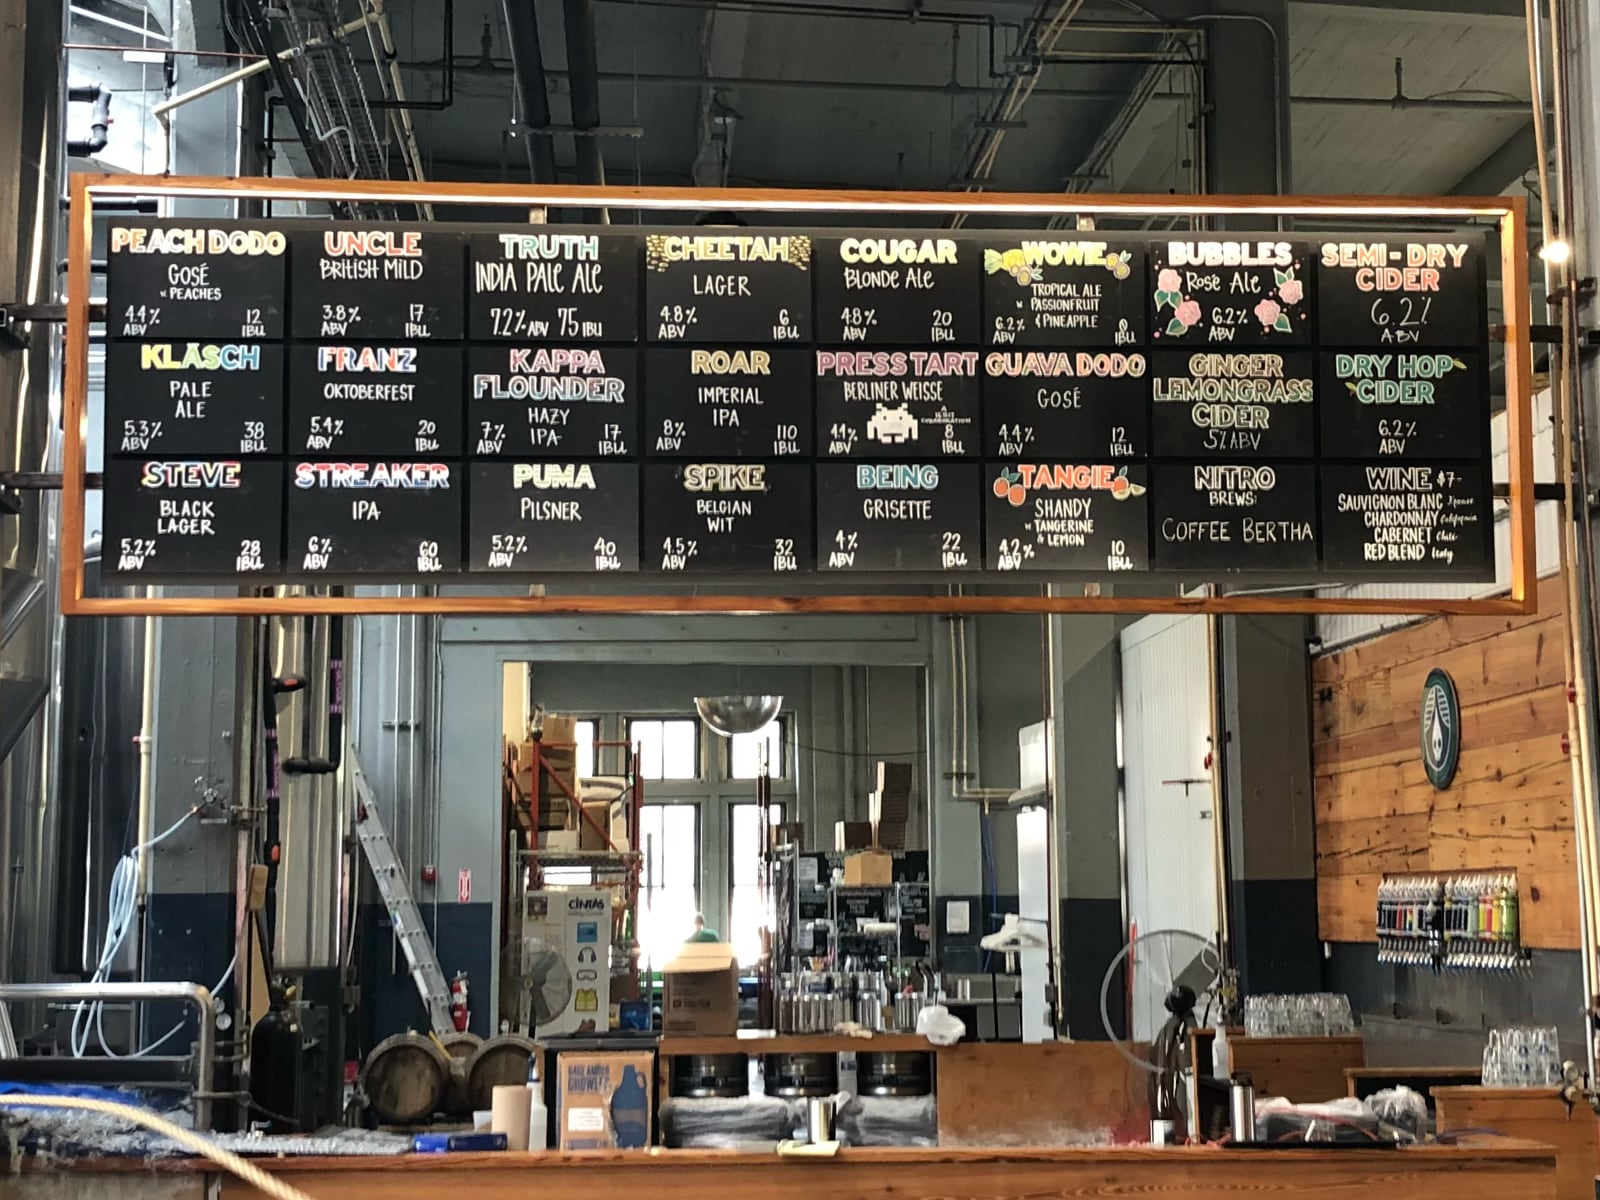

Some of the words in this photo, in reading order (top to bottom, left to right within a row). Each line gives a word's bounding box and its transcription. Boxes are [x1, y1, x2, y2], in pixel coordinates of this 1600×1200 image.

[112, 228, 205, 254] PEACH
[208, 229, 286, 255] DODO
[324, 231, 422, 256] UNCLE
[499, 234, 598, 260] TRUTH
[663, 236, 790, 262] CHEETAH
[840, 238, 957, 264] COUGAR
[1020, 241, 1108, 267] WOWIE
[1168, 241, 1292, 266] BUBBLES
[168, 263, 209, 286] GOSÉ
[476, 262, 517, 292] INDIA
[1356, 266, 1439, 291] CIDER
[170, 287, 221, 300] PEACHES
[694, 275, 751, 296] LAGER
[1031, 283, 1080, 297] TROPICAL
[1083, 284, 1101, 297] ALE
[410, 304, 423, 321] 17
[1031, 297, 1099, 311] PASSIONFRUIT
[1371, 297, 1431, 326] 6.2%
[247, 309, 261, 324] 12
[323, 305, 361, 323] 3.8%
[527, 321, 549, 336] ABV
[558, 308, 579, 336] 75
[583, 322, 602, 337] IBU
[660, 305, 697, 324] 4.8%
[780, 309, 789, 325] 6
[933, 310, 952, 326] 20
[1043, 313, 1098, 328] PINEAPPLE
[1212, 307, 1248, 324] 6.2%
[123, 323, 147, 335] ABV
[242, 325, 265, 337] IBU
[321, 321, 347, 336] ABV
[406, 322, 430, 337] IBU
[659, 324, 685, 338] ABV
[773, 325, 800, 340] IBU
[843, 326, 866, 340] ABV
[932, 327, 955, 342] IBU
[993, 329, 1015, 344] ABV
[1209, 326, 1235, 341] ABV
[1381, 328, 1419, 343] ABV
[1115, 330, 1136, 345] IBU
[318, 347, 417, 372] FRANZ
[510, 349, 605, 374] KAPPA
[692, 350, 770, 374] ROAR
[816, 351, 907, 376] PRESS
[910, 352, 979, 376] TART
[985, 352, 1074, 376] GUAVA
[1076, 353, 1145, 377] DODO
[1189, 353, 1283, 379] GINGER
[1336, 354, 1392, 377] DRY
[1398, 355, 1454, 378] HOP
[170, 381, 211, 397] PALE
[324, 383, 415, 400] OKTOBERFEST
[474, 375, 624, 402] FLOUNDER
[699, 387, 763, 404] IMPERIAL
[844, 381, 898, 401] BERLINER
[902, 381, 942, 401] WEISSE
[1153, 376, 1313, 403] LEMONGRASS
[1354, 379, 1434, 404] CIDER
[1038, 387, 1081, 408] GOSÉ
[175, 400, 205, 418] ALE
[528, 407, 569, 425] HAZY
[714, 409, 739, 426] IPA
[1192, 402, 1269, 429] CIDER
[124, 420, 161, 438] 5.3%
[245, 422, 264, 439] 38
[311, 416, 343, 435] 5.4%
[418, 420, 435, 435] 20
[481, 422, 505, 440] 7%
[605, 424, 621, 440] 17
[664, 419, 685, 437] 8%
[778, 425, 797, 439] 110
[945, 424, 953, 440] 8
[999, 424, 1034, 442] 4.4%
[1379, 420, 1416, 437] 6.2%
[121, 436, 149, 450] ABV
[307, 435, 332, 449] ABV
[531, 428, 561, 446] IPA
[1113, 427, 1126, 442] 12
[1230, 432, 1260, 450] ABV
[241, 440, 267, 453] IBU
[416, 438, 439, 451] IBU
[477, 439, 502, 454] ABV
[599, 441, 627, 455] IBU
[656, 437, 681, 450] ABV
[774, 441, 800, 455] IBU
[829, 440, 851, 454] ABV
[942, 440, 965, 454] IBU
[999, 443, 1023, 455] ABV
[1110, 443, 1134, 456] IBU
[1379, 439, 1405, 454] ABV
[142, 461, 241, 488] STEVE
[295, 463, 449, 489] STREAKER
[514, 464, 596, 489] PUMA
[684, 464, 765, 491] SPIKE
[857, 465, 938, 489] BEING
[1016, 464, 1116, 492] TANGIE
[1195, 466, 1275, 490] NITRO
[1366, 467, 1432, 491] WINE
[160, 500, 214, 517] BLACK
[353, 501, 381, 520] IPA
[521, 497, 581, 520] PILSNER
[697, 499, 751, 515] BELGIAN
[864, 499, 931, 519] GRISETTE
[1035, 498, 1091, 519] SHANDY
[1338, 494, 1404, 512] SAUVIGNON
[1407, 493, 1443, 511] BLANC
[158, 518, 215, 534] LAGER
[708, 517, 734, 532] WIT
[1034, 520, 1093, 533] TANGERINE
[1365, 509, 1439, 529] CHARDONNAY
[1163, 518, 1230, 541] COFFEE
[1243, 518, 1313, 542] BERTHA
[1375, 526, 1432, 545] CABERNET
[120, 538, 155, 558] 5.2%
[240, 540, 261, 557] 28
[309, 536, 332, 554] 6%
[492, 535, 527, 553] 5.2%
[594, 537, 616, 557] 40
[774, 539, 793, 557] 32
[943, 532, 960, 550] 22
[1048, 534, 1084, 546] LEMON
[1112, 540, 1124, 556] 10
[419, 541, 438, 559] 60
[1364, 542, 1386, 560] RED
[1388, 544, 1425, 561] BLEND
[118, 554, 144, 570] ABV
[236, 555, 264, 571] IBU
[303, 554, 329, 569] ABV
[418, 555, 442, 571] IBU
[489, 552, 513, 568] ABV
[596, 554, 621, 570] IBU
[662, 554, 685, 570] ABV
[774, 554, 797, 571] IBU
[829, 552, 854, 568] ABV
[943, 552, 967, 569] IBU
[998, 554, 1021, 570] ABV
[1108, 554, 1133, 571] IBU
